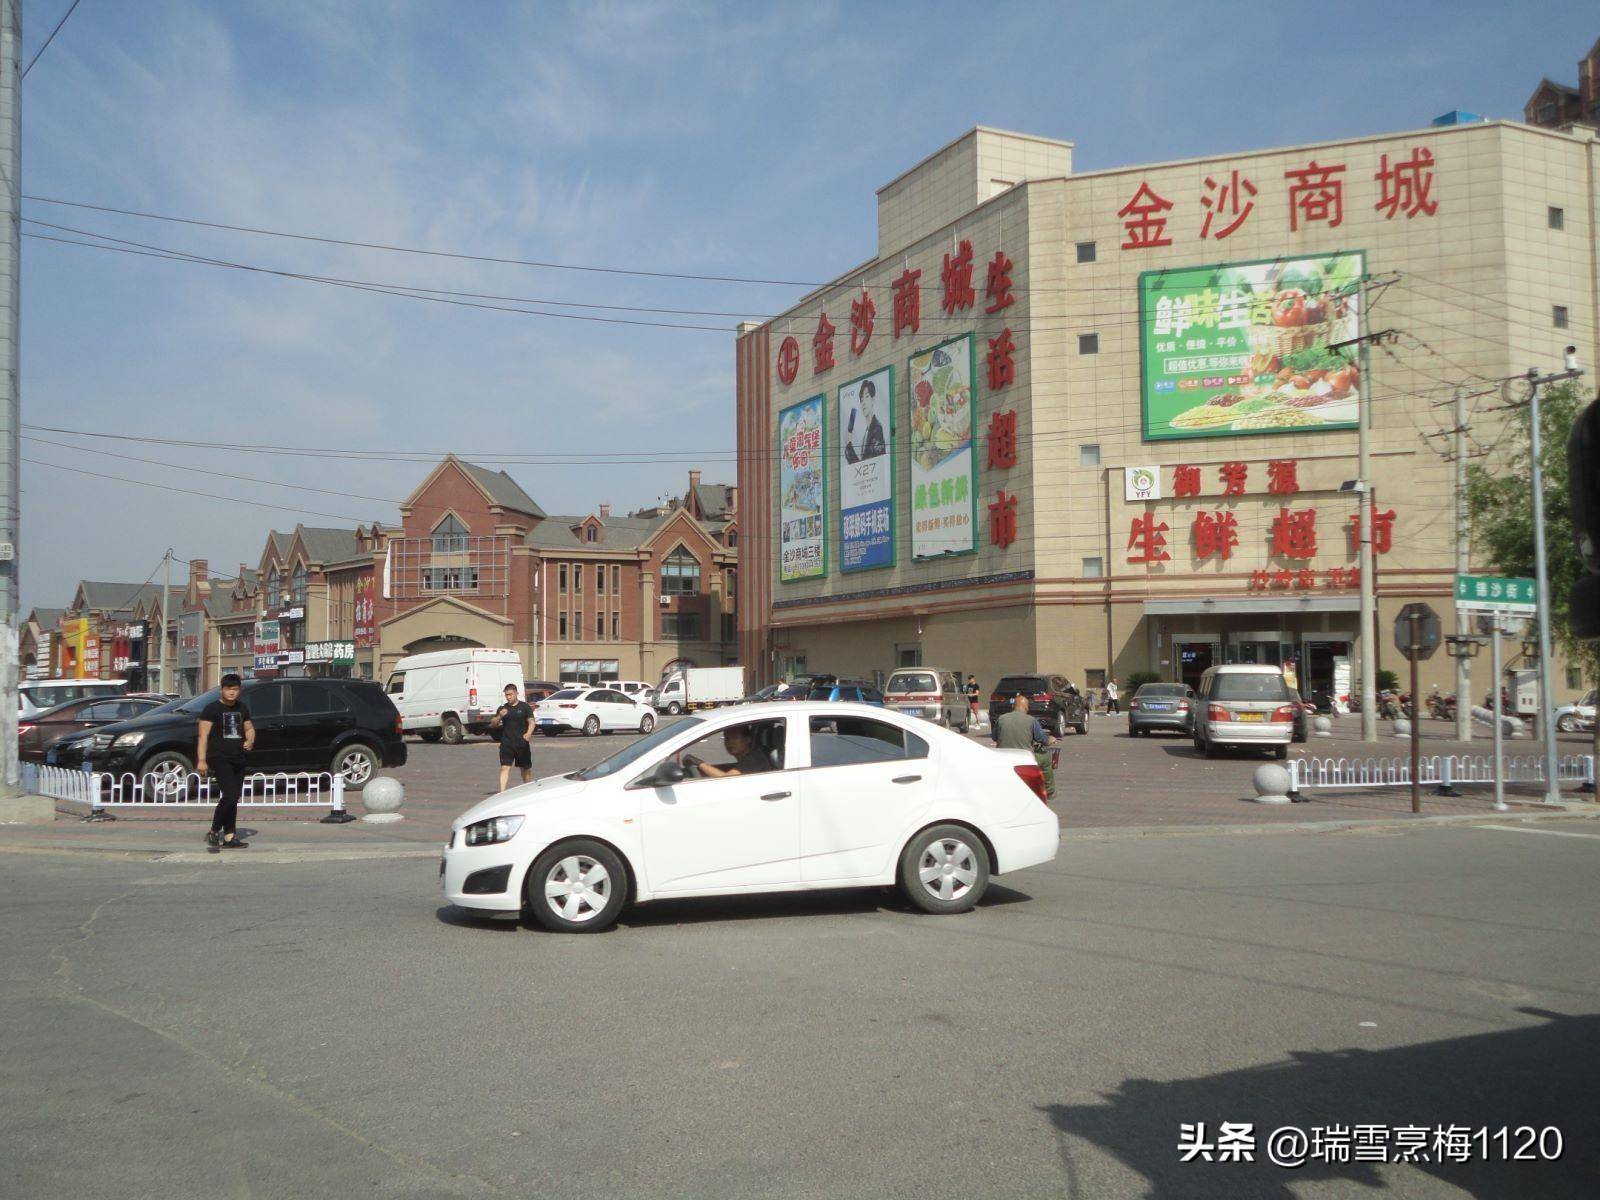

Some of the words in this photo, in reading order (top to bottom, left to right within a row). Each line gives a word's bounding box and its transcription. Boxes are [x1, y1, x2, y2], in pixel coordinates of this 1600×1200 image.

[1117, 147, 1438, 250] 金沙商城
[813, 239, 975, 375] 金沙商城
[985, 251, 1018, 550] 生活超市
[854, 462, 876, 478] X27
[783, 544, 821, 564] 金沙商城三楼
[1127, 507, 1397, 563] 生鲜超市
